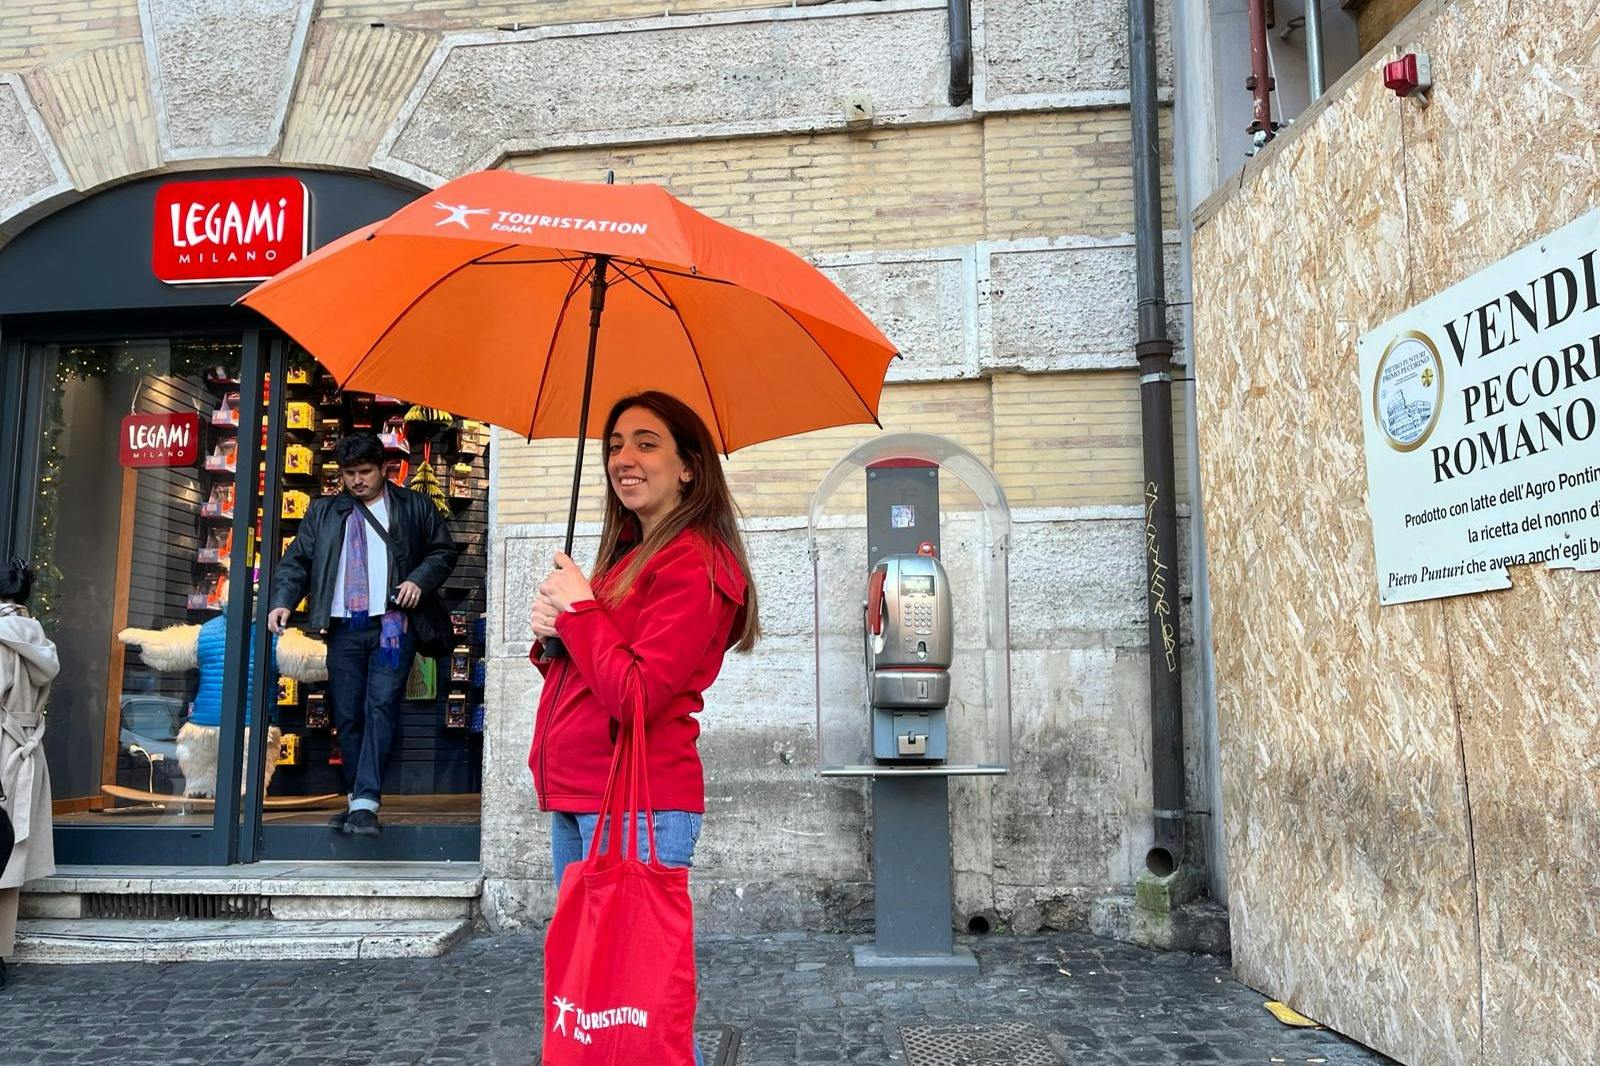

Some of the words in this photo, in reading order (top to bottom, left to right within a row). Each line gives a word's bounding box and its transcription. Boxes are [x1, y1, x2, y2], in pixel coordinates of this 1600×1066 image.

[490, 222, 533, 234] ROMA
[498, 211, 648, 235] TOURISTATION
[179, 249, 277, 264] MILANO
[1443, 249, 1600, 368] VENDI
[133, 450, 184, 458] MILANO
[1430, 397, 1596, 484] ROMANO
[1405, 507, 1447, 528] Prodotto
[1449, 502, 1469, 517] con
[1470, 494, 1497, 512] latte
[1500, 480, 1556, 505] dell'Agro
[1467, 528, 1479, 543] la
[1481, 520, 1519, 541] ricetta
[1521, 513, 1542, 533] del
[1544, 506, 1587, 528] nonno
[1388, 572, 1418, 588] Pietro
[1420, 560, 1465, 583] Punturi
[1466, 559, 1487, 574] che
[1489, 554, 1525, 571] aveva
[1528, 539, 1588, 563] anch'egli
[1590, 537, 1600, 554] b
